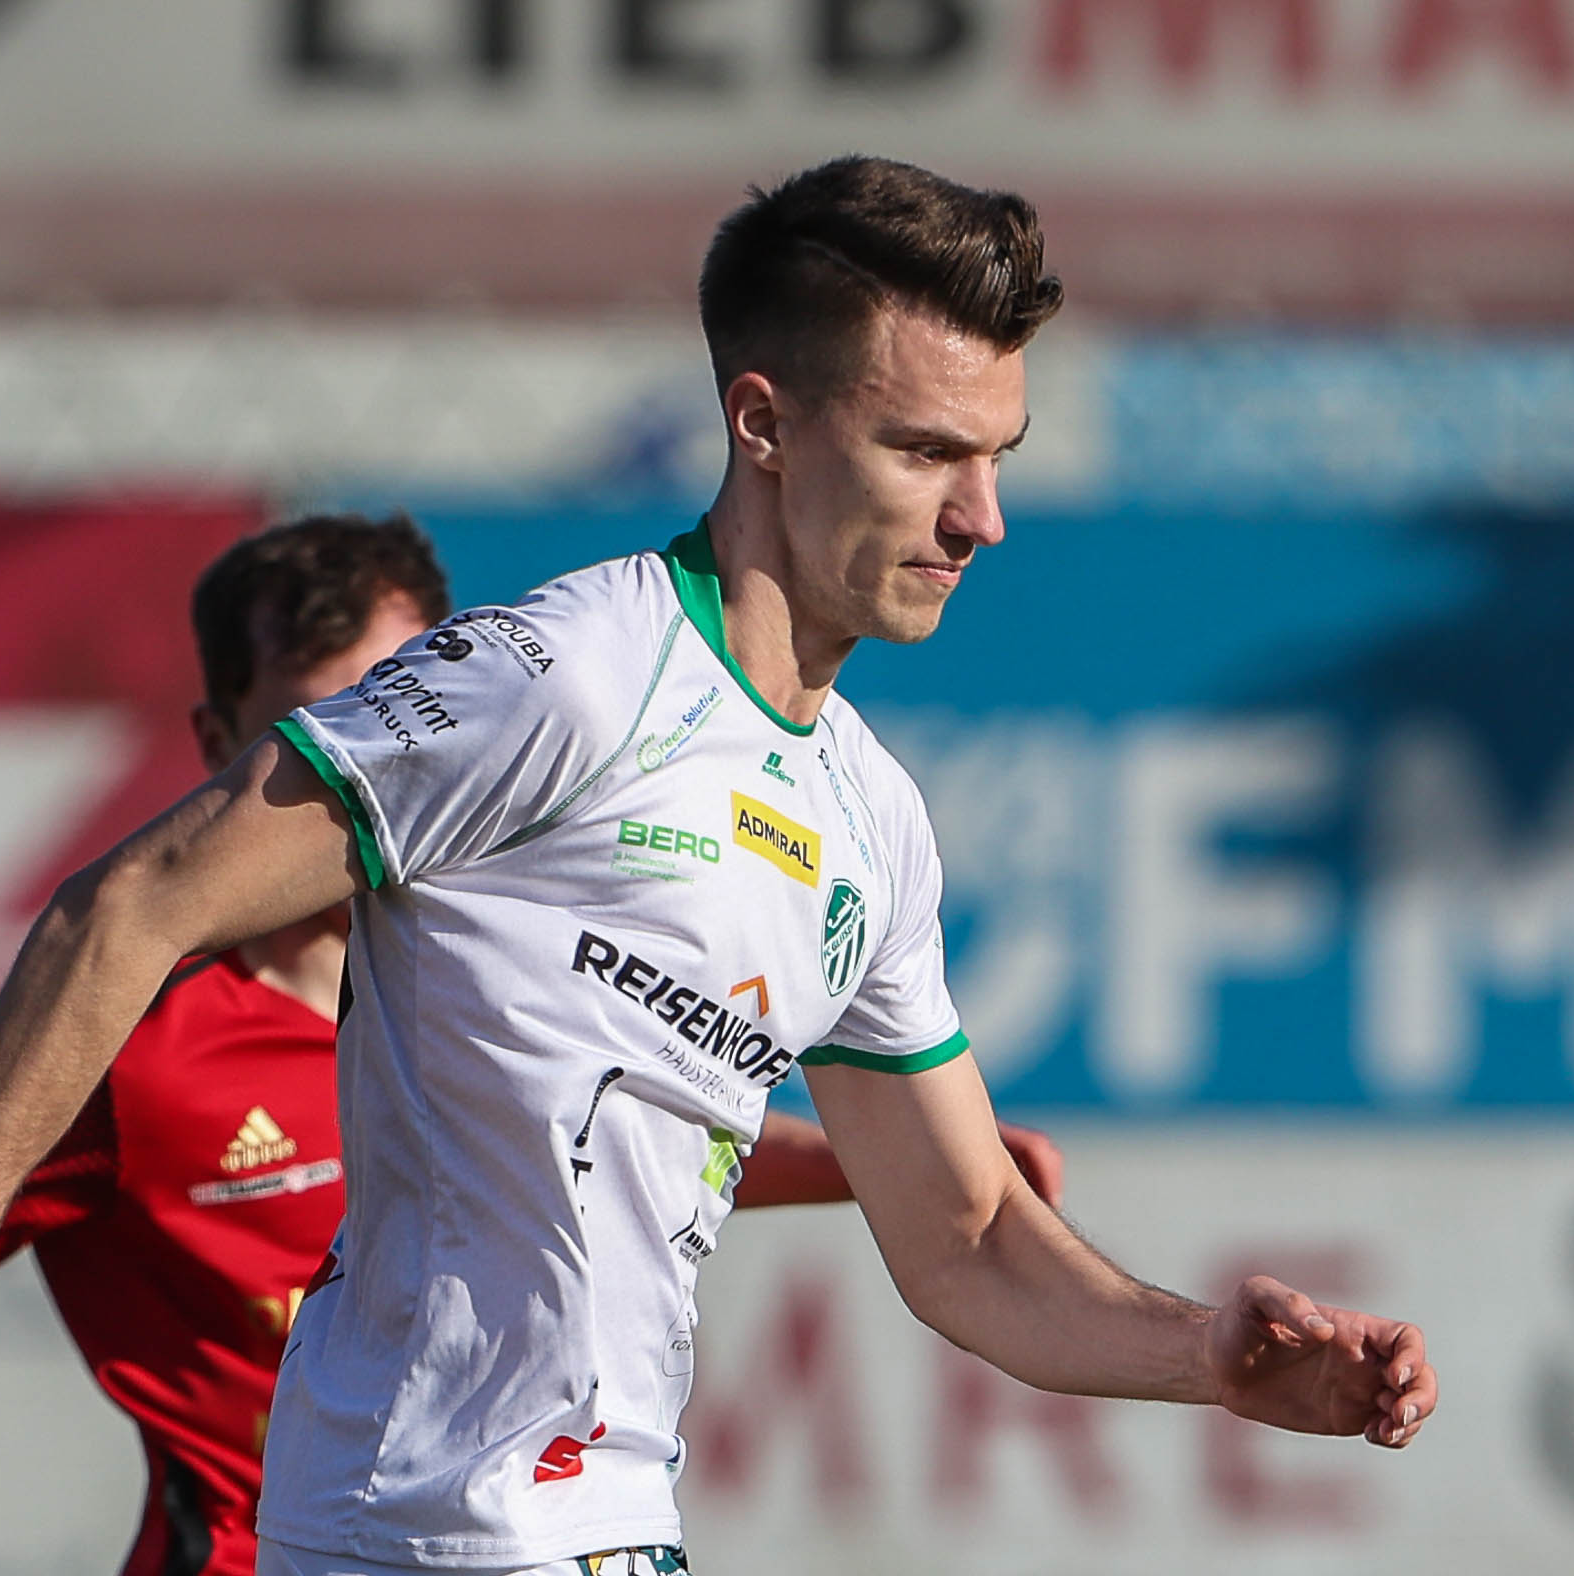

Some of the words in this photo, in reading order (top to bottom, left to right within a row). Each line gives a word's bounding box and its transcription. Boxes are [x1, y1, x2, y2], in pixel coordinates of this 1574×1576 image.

[681, 685, 721, 727] Solution
[617, 819, 720, 864] BERO
[737, 808, 815, 872] ADMIRAL
[656, 1040, 745, 1113] HAUSTECHNIK
